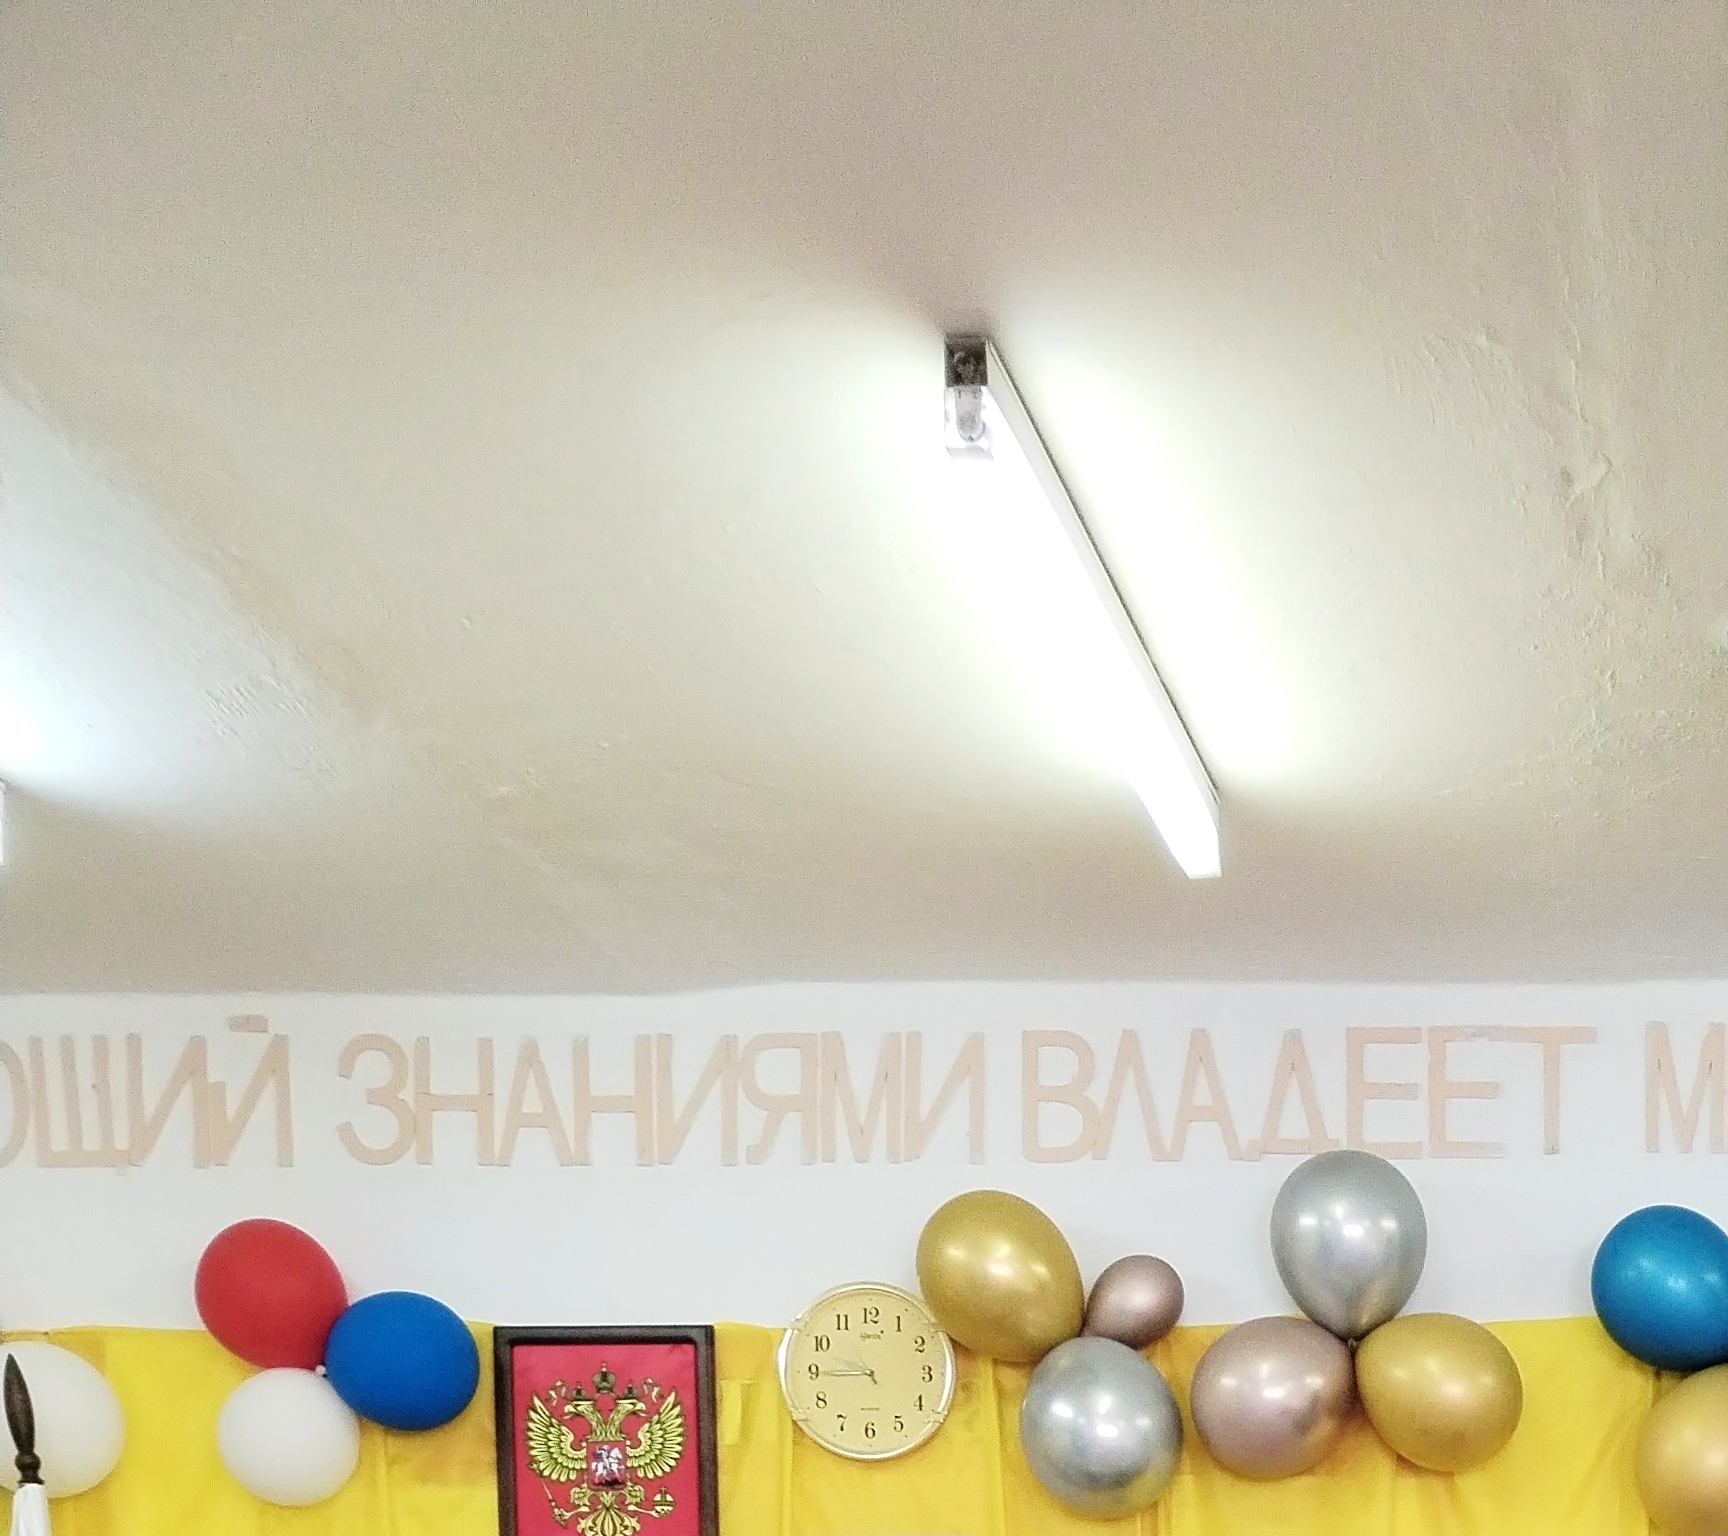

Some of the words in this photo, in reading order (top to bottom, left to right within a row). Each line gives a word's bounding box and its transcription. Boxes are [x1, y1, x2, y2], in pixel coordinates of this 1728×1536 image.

[337, 1031, 985, 1168] ЗНАНИЯМИ
[1021, 1025, 1597, 1163] ВЛАДЕЕТ
[836, 1314, 849, 1331] 11
[863, 1307, 879, 1324] 12
[895, 1315, 902, 1332] 1
[814, 1335, 830, 1352] 10
[914, 1336, 926, 1353] 2
[808, 1363, 820, 1381] 9
[922, 1365, 933, 1383] 3
[816, 1391, 827, 1409] 8
[914, 1394, 923, 1411] 4
[837, 1414, 847, 1432] 7
[865, 1422, 876, 1439] 6
[894, 1415, 904, 1432] 5
